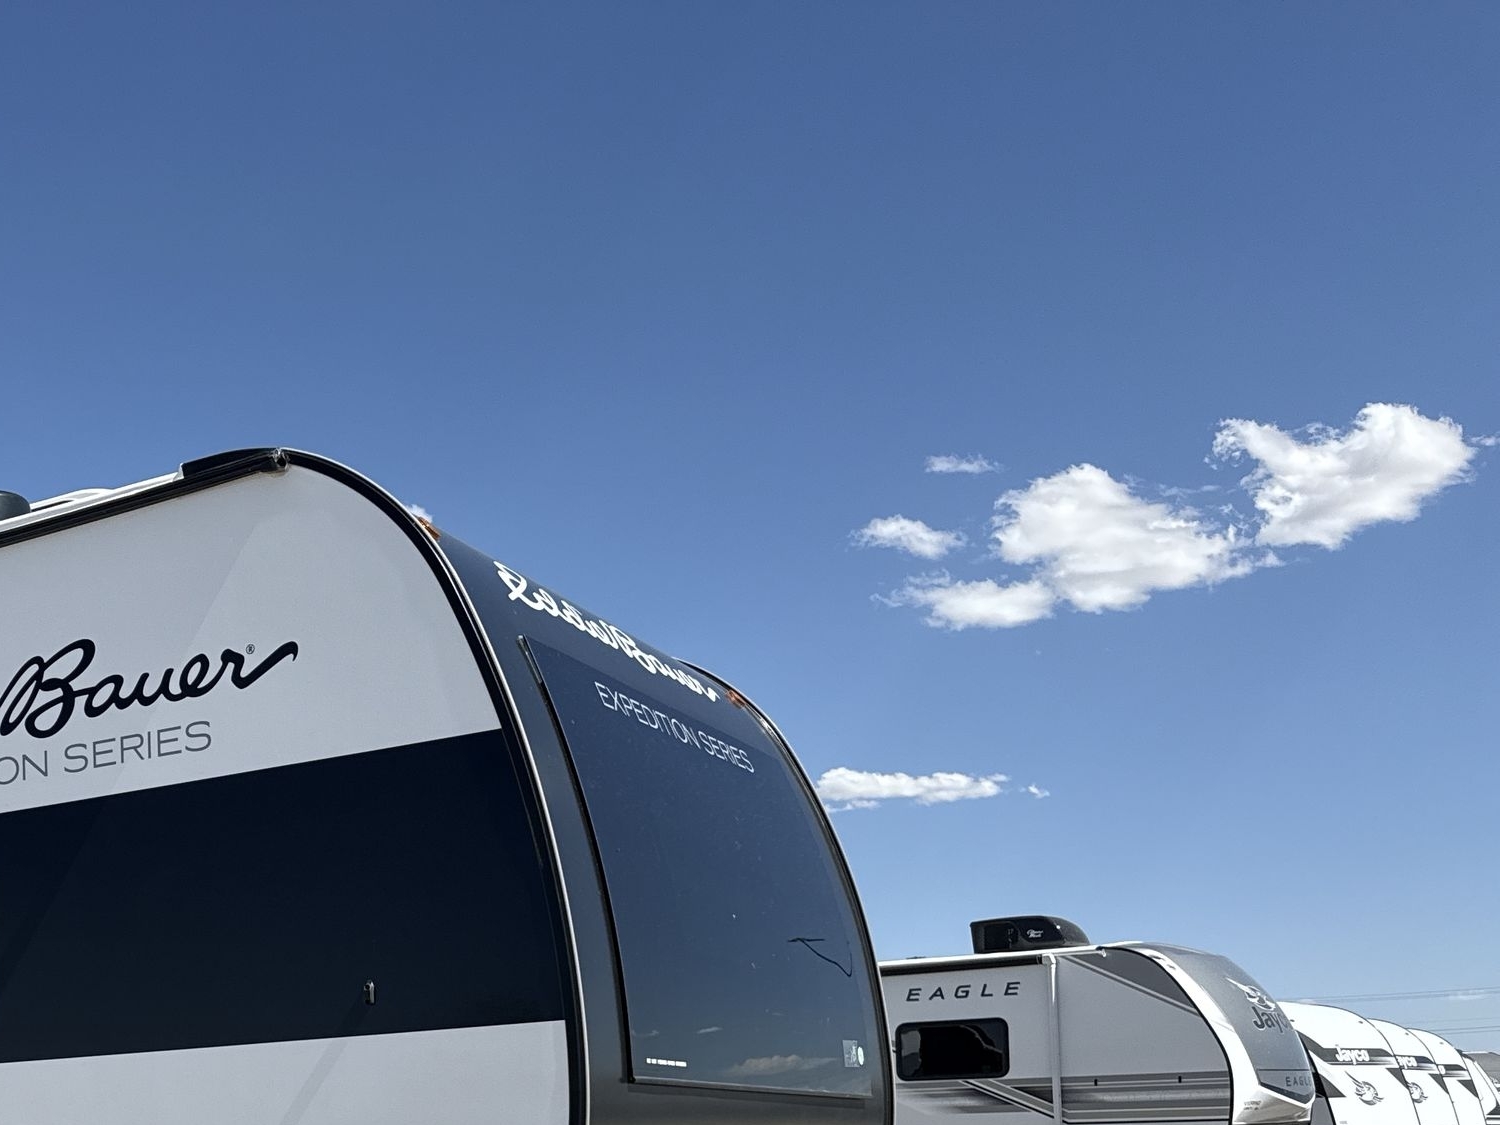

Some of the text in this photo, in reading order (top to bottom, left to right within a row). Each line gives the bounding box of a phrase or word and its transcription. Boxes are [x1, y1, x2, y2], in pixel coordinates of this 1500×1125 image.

[594, 681, 755, 773] EXPEDITION SERIES
[63, 721, 213, 774] SERIES
[906, 981, 1021, 1002] EAGLE
[1251, 1006, 1289, 1034] Jayc
[1335, 1045, 1371, 1066] Jayco
